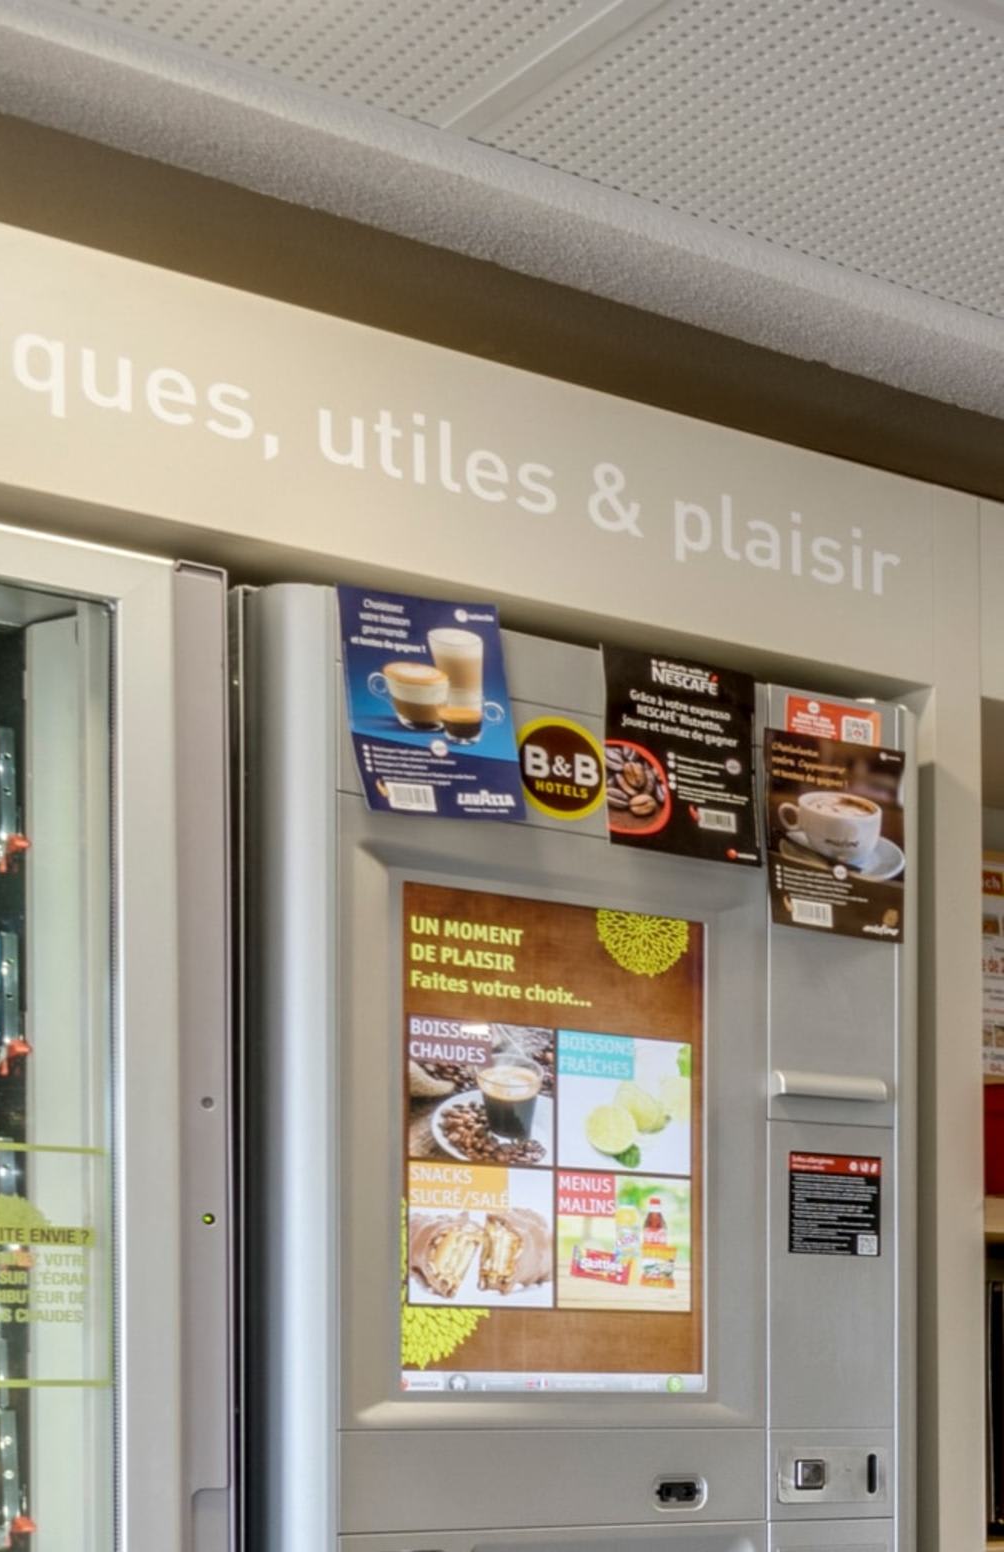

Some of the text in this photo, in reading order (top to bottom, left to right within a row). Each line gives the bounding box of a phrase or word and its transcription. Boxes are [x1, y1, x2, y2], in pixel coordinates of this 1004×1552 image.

[318, 408, 557, 515] utiles
[587, 462, 644, 538] &
[674, 493, 901, 596] plaisir
[525, 744, 599, 787] B&B
[535, 780, 589, 799] HOTELS
[410, 915, 524, 947] UN MOMENT
[410, 942, 516, 972] DE PLAISIR
[410, 970, 592, 1007] Faites votre choix...
[409, 1041, 487, 1063] CHAUDES
[410, 1166, 473, 1184] SNACKS
[558, 1174, 612, 1194] MENUS
[558, 1196, 616, 1216] MALINS
[30, 1228, 77, 1243] ENVIE
[81, 1229, 90, 1244] ?
